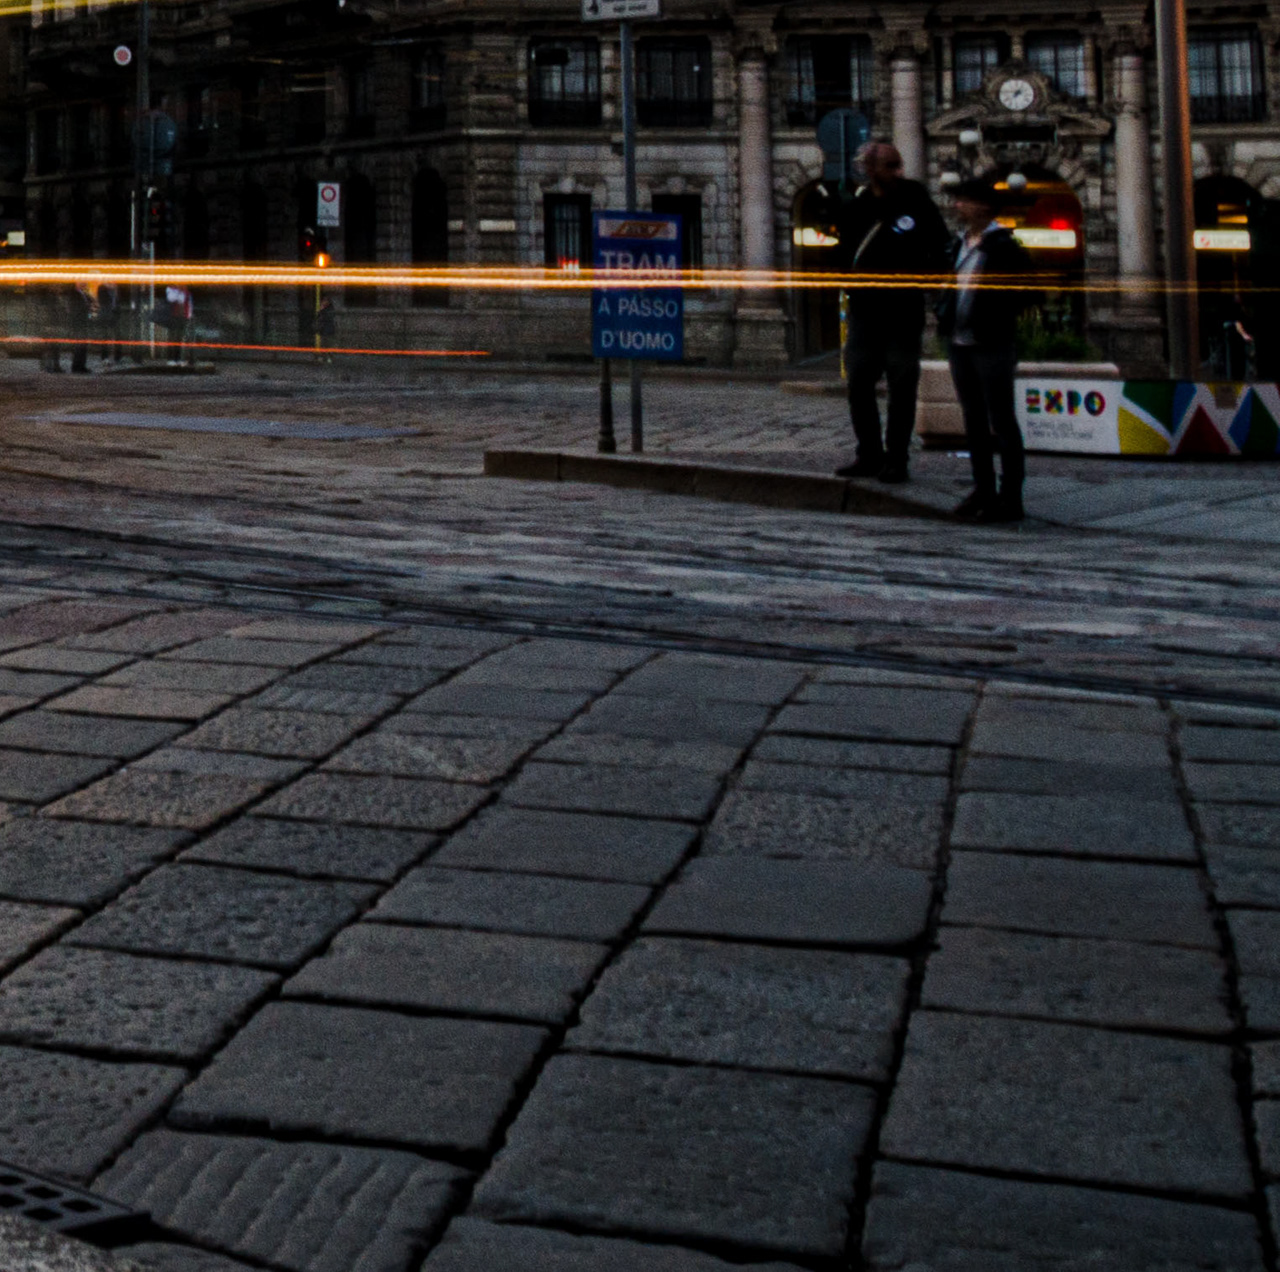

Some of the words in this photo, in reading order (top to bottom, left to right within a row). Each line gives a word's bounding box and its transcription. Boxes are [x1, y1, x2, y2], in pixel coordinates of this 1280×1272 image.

[600, 250, 677, 281] TRAM
[617, 297, 678, 318] PASSO
[601, 330, 675, 351] D'UOMO
[1026, 389, 1105, 416] EXPO
